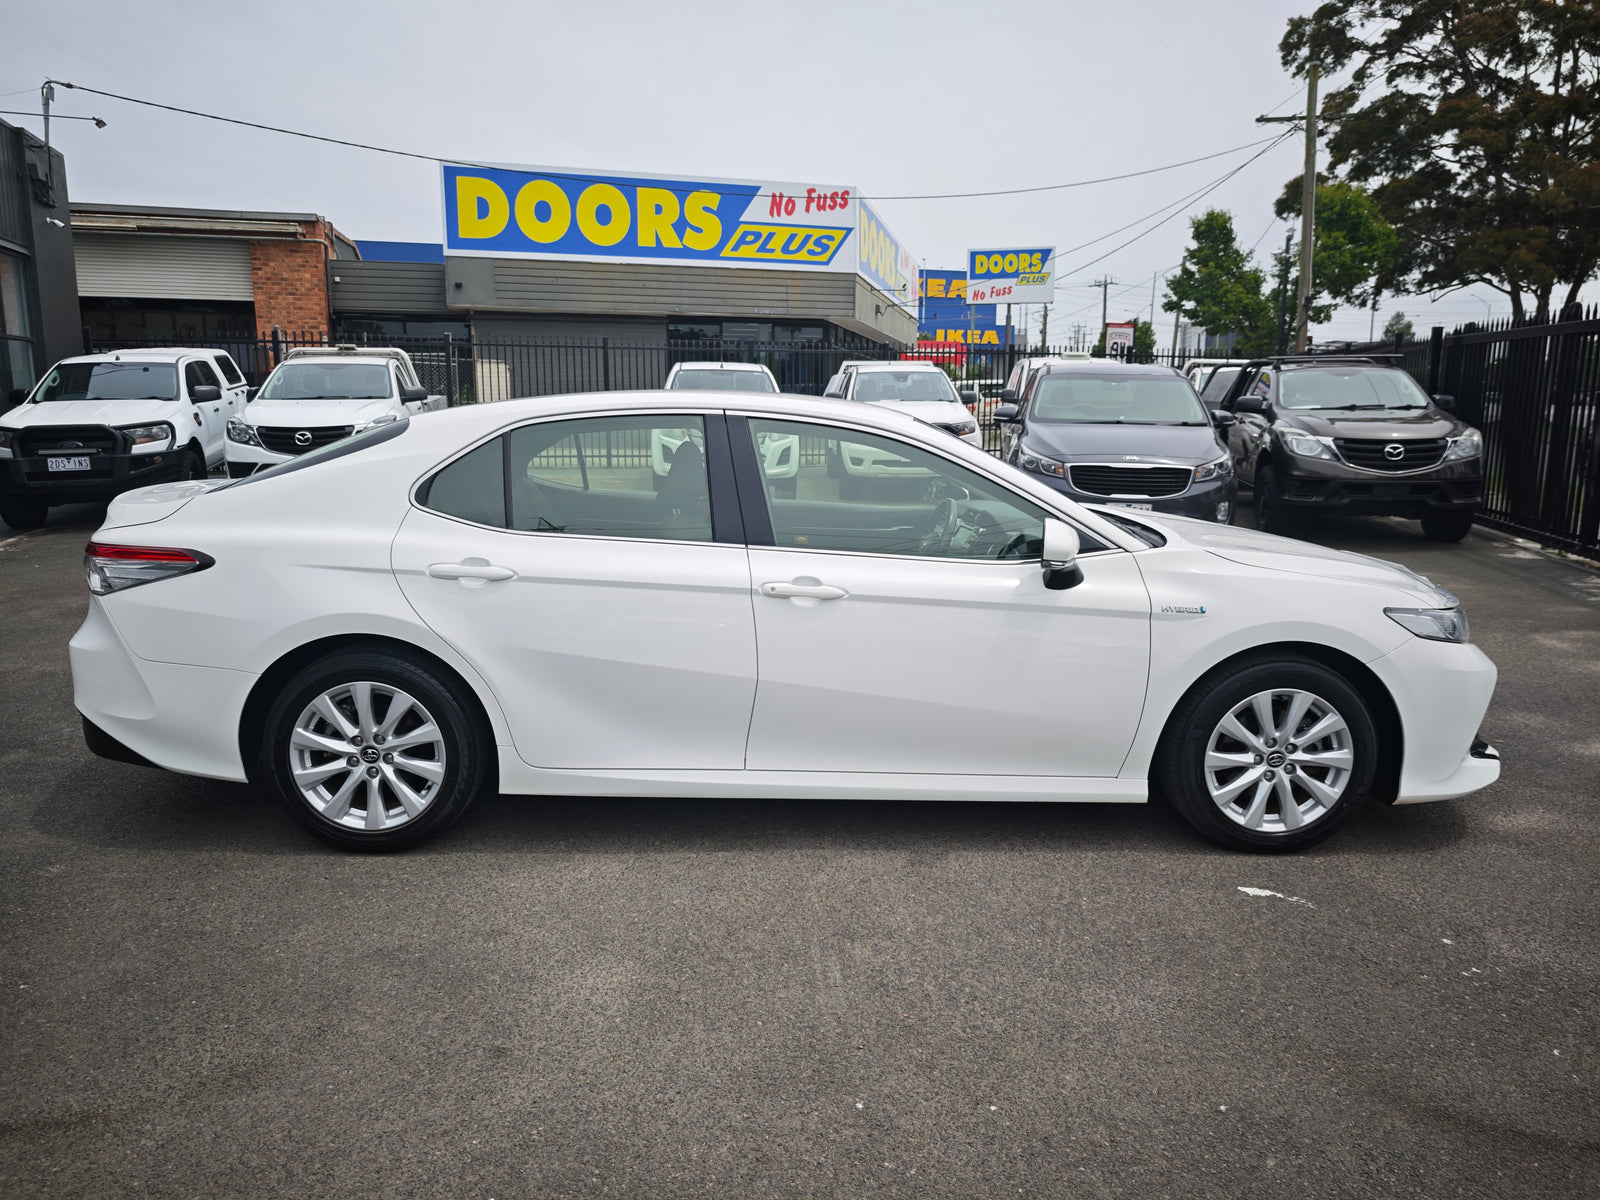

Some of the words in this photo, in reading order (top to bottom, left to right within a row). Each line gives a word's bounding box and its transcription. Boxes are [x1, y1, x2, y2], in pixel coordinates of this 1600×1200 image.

[769, 192, 796, 218] No
[805, 187, 850, 214] Fuss
[456, 175, 723, 251] DOORS
[729, 230, 836, 257] PLUS
[860, 207, 896, 289] DOORS
[975, 252, 1042, 274] DOORS
[1020, 275, 1046, 284] PLUS
[972, 289, 986, 301] No
[990, 286, 1013, 298] Fuss
[936, 329, 1000, 345] IKEA
[49, 459, 66, 469] 2DS
[1161, 605, 1200, 614] HYBRID
